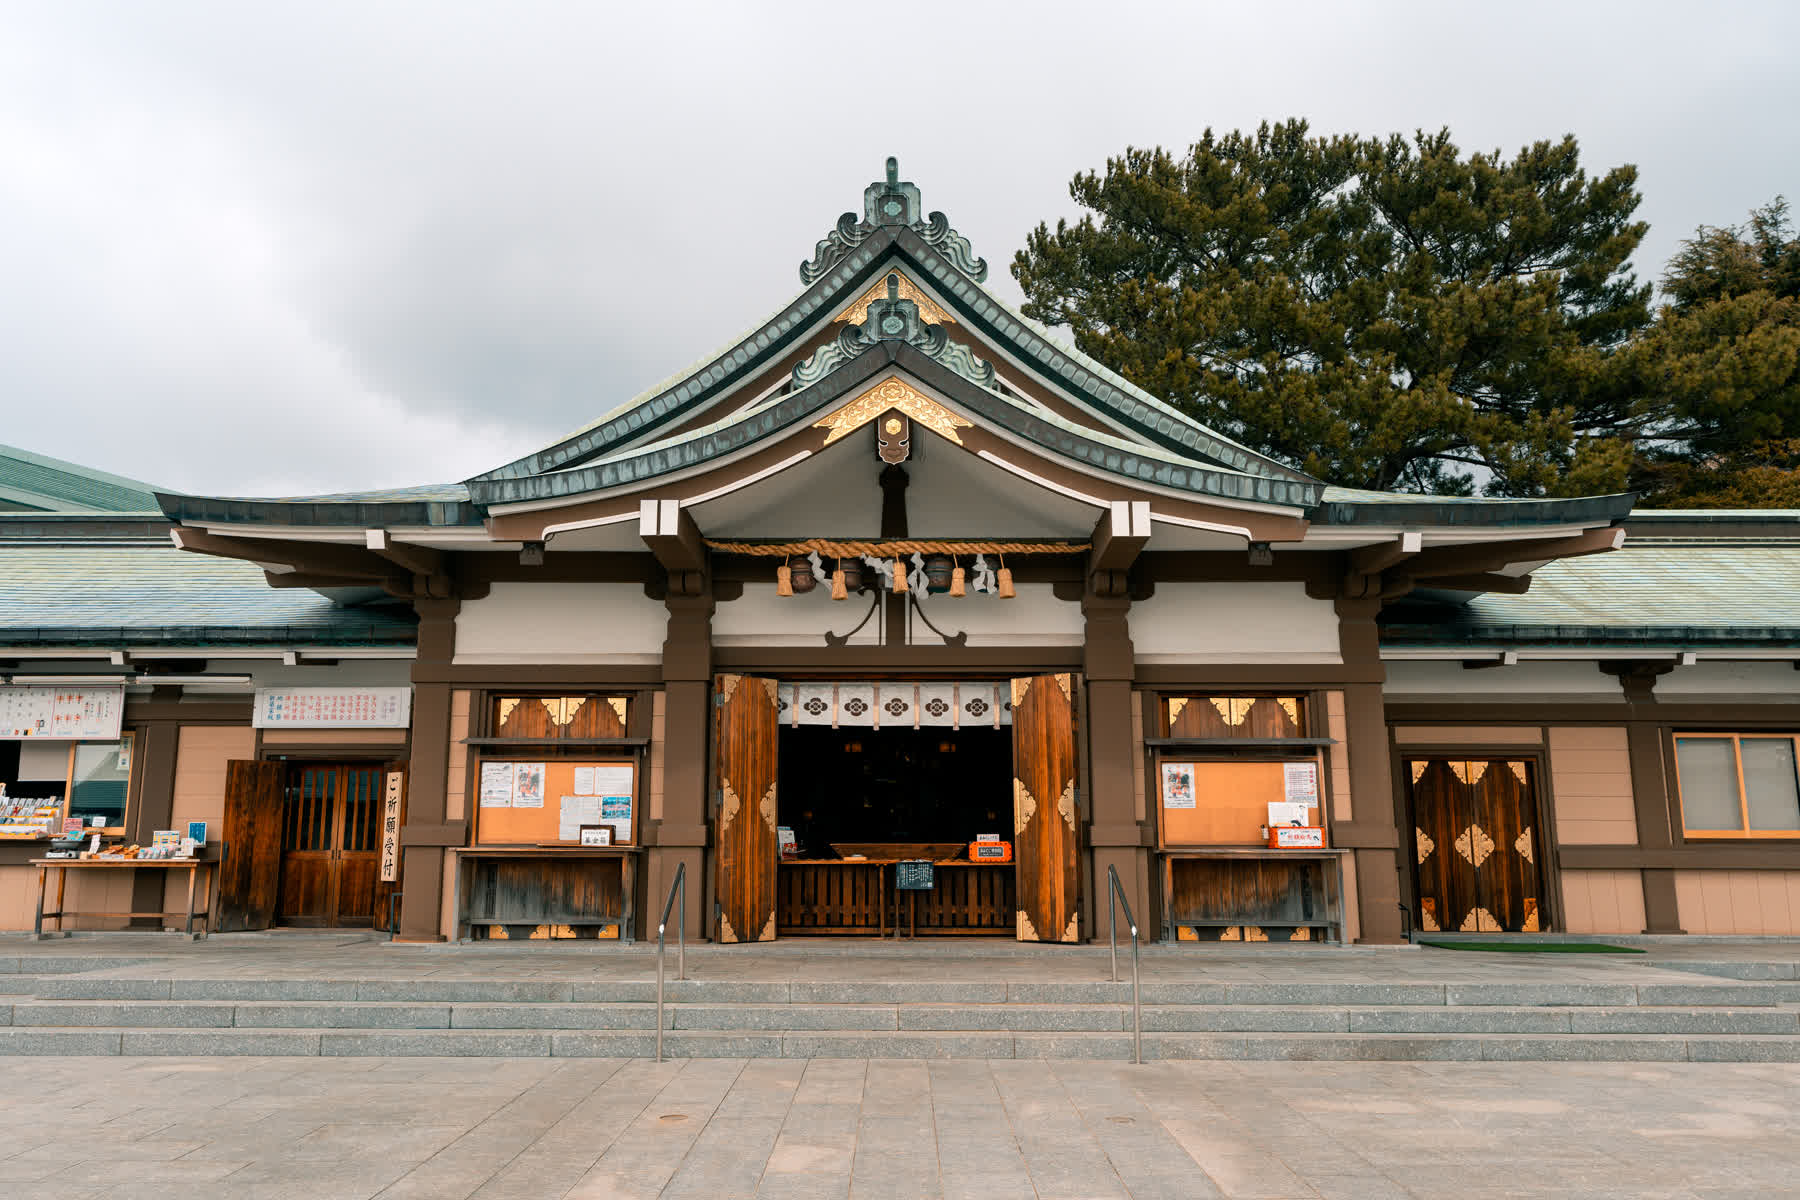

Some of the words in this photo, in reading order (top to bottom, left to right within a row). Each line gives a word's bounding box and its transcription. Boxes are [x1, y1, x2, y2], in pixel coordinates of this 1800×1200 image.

[383, 776, 399, 879] ご祈願受付
